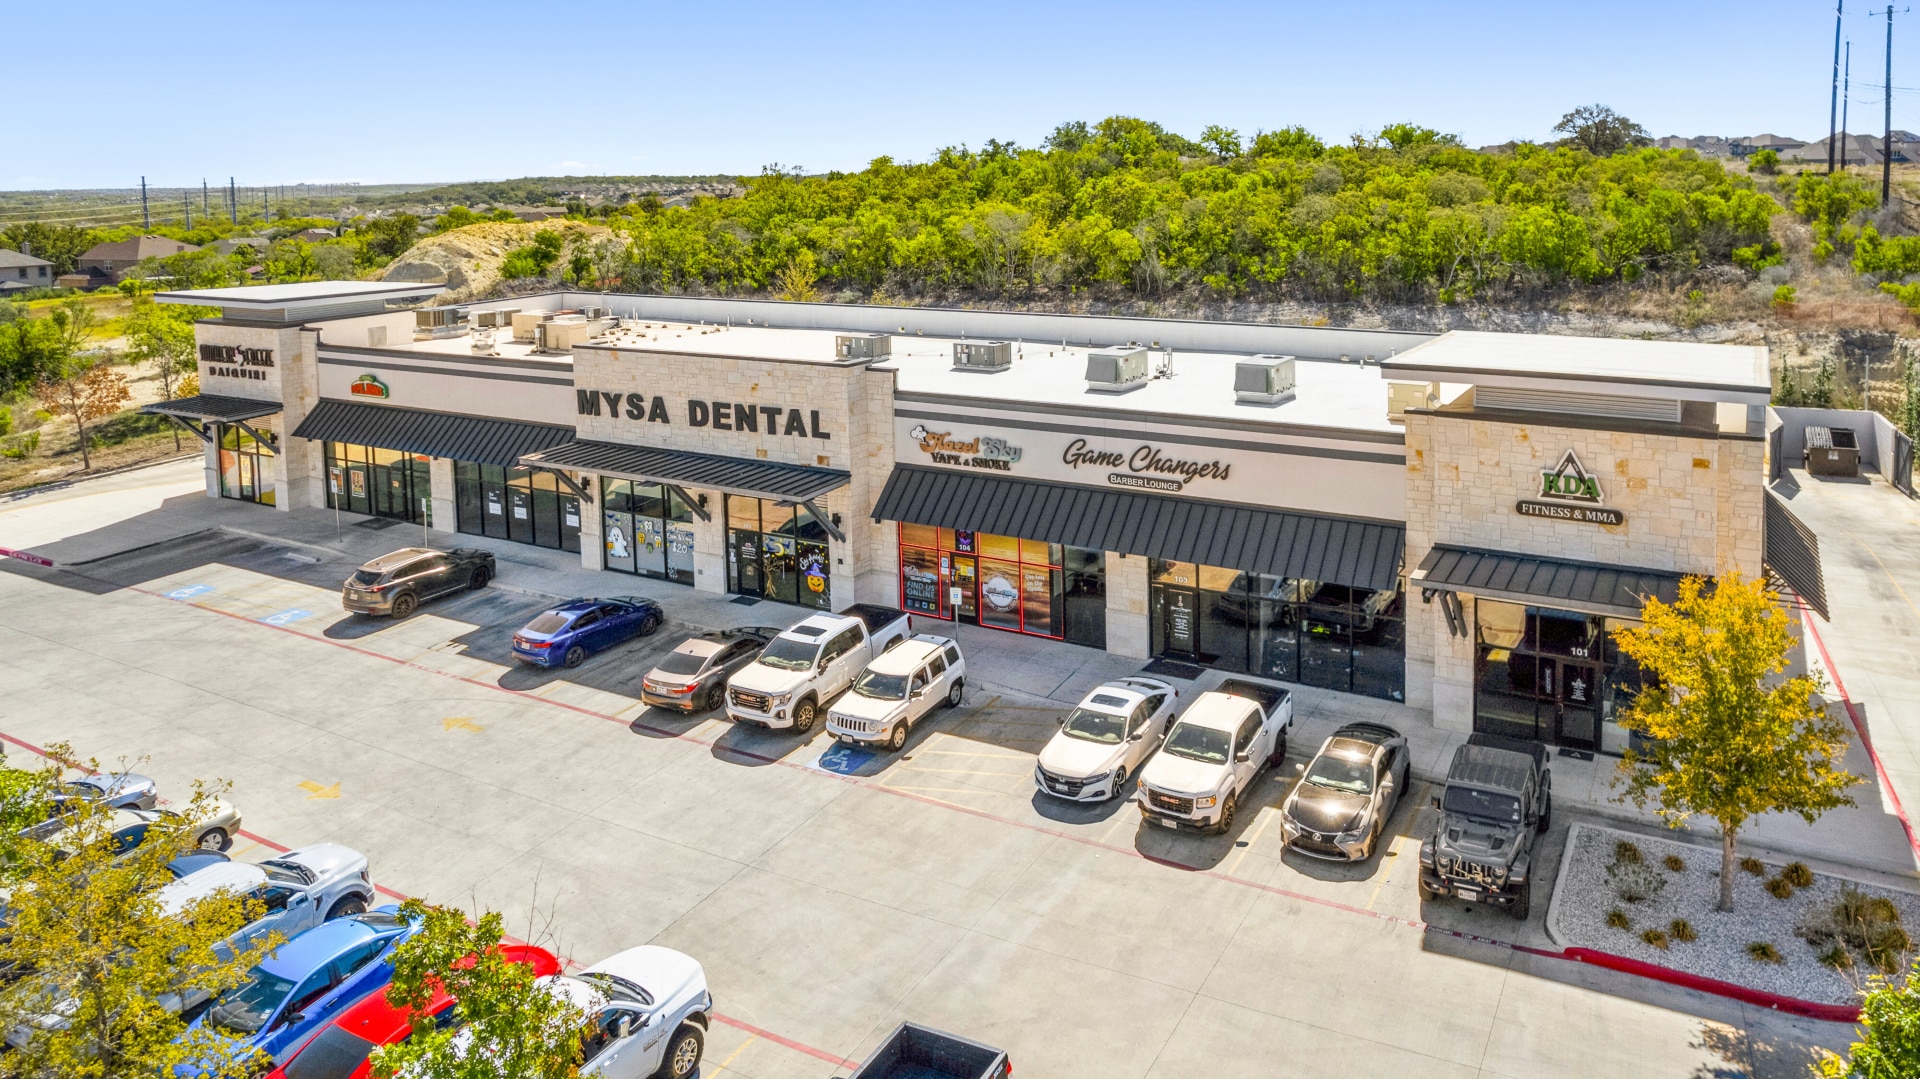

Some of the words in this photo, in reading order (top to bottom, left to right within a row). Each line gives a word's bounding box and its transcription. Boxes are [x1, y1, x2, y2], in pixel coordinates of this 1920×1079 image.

[209, 366, 266, 380] DAIQUIRI
[576, 389, 670, 424] MYSA
[688, 399, 831, 440] DENTAL
[919, 431, 980, 454] Hazel
[981, 437, 1023, 464] Sky
[930, 451, 962, 466] VAPE
[963, 458, 970, 467] &
[971, 456, 1011, 471] SMOKE
[1062, 438, 1126, 469] Game
[1128, 445, 1232, 485] Changers
[1110, 474, 1144, 486] BARBER
[1144, 478, 1179, 491] LOUNGE
[1522, 503, 1570, 518] FITNESS
[1573, 509, 1583, 519] &
[1585, 510, 1617, 523] MMA
[672, 542, 688, 554] $20
[906, 580, 924, 590] FIND
[925, 584, 935, 592] US
[1174, 575, 1189, 584] 103
[906, 588, 935, 599] ONLINE
[1570, 646, 1588, 657] 101
